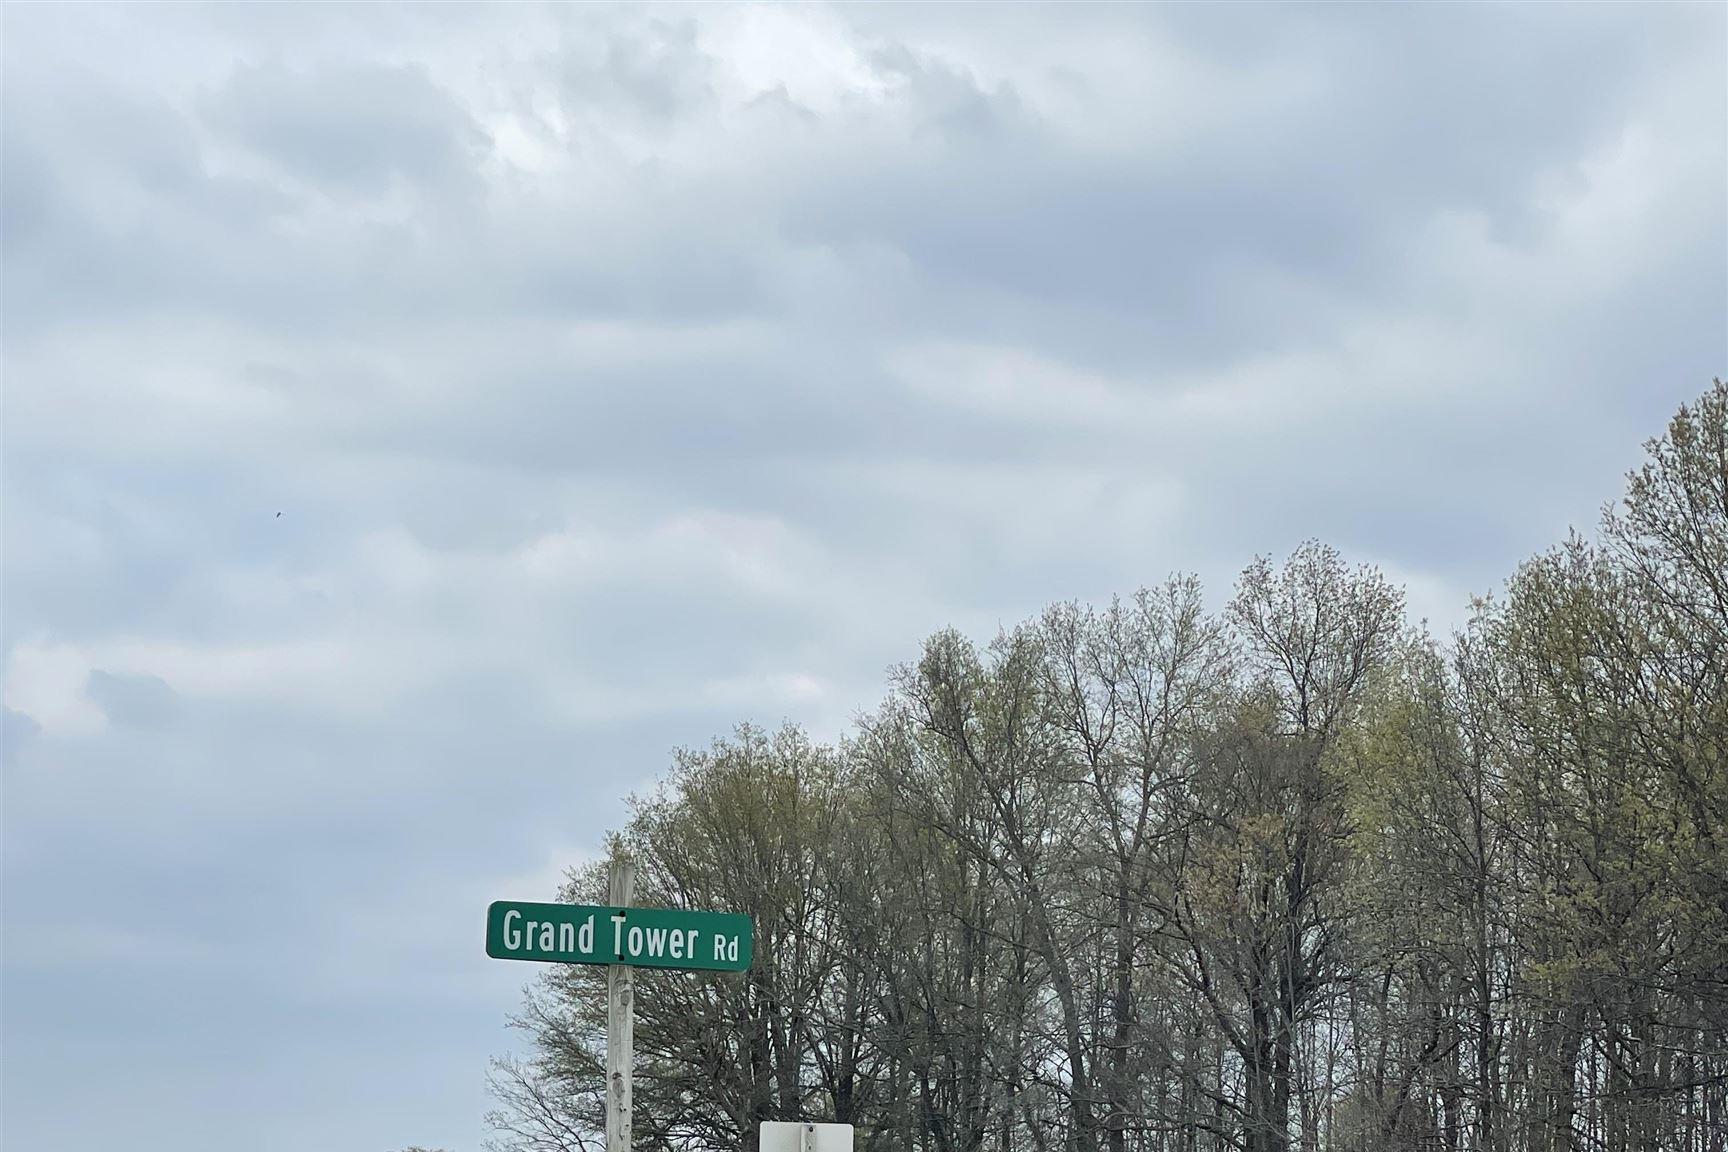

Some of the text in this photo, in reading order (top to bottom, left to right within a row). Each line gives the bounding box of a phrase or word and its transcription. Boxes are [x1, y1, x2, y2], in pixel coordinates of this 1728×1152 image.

[503, 909, 739, 962] Grand Tower Rd
